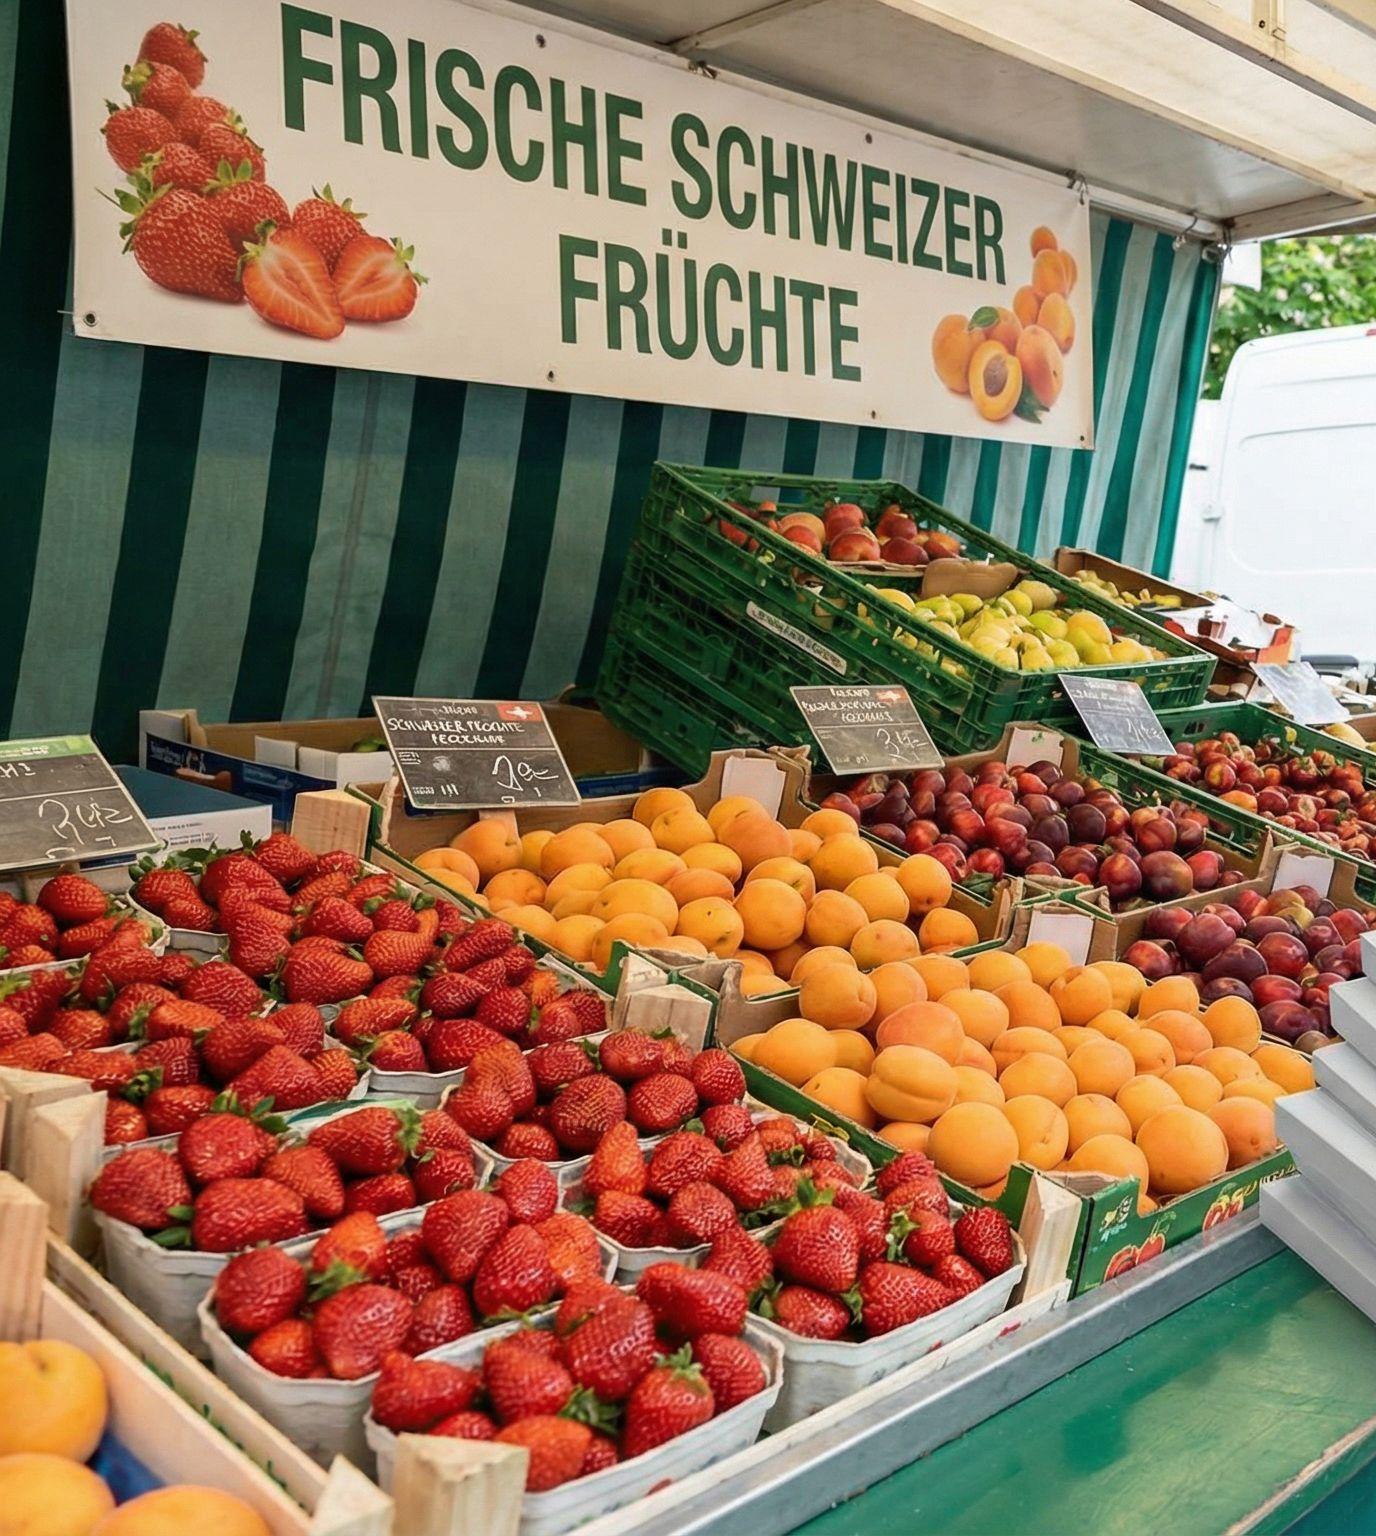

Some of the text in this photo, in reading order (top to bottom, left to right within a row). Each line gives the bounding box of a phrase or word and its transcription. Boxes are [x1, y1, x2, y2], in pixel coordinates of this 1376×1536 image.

[281, 4, 1007, 285] FRISCHE SCHWEIZER
[558, 227, 862, 383] FRÜCHTE
